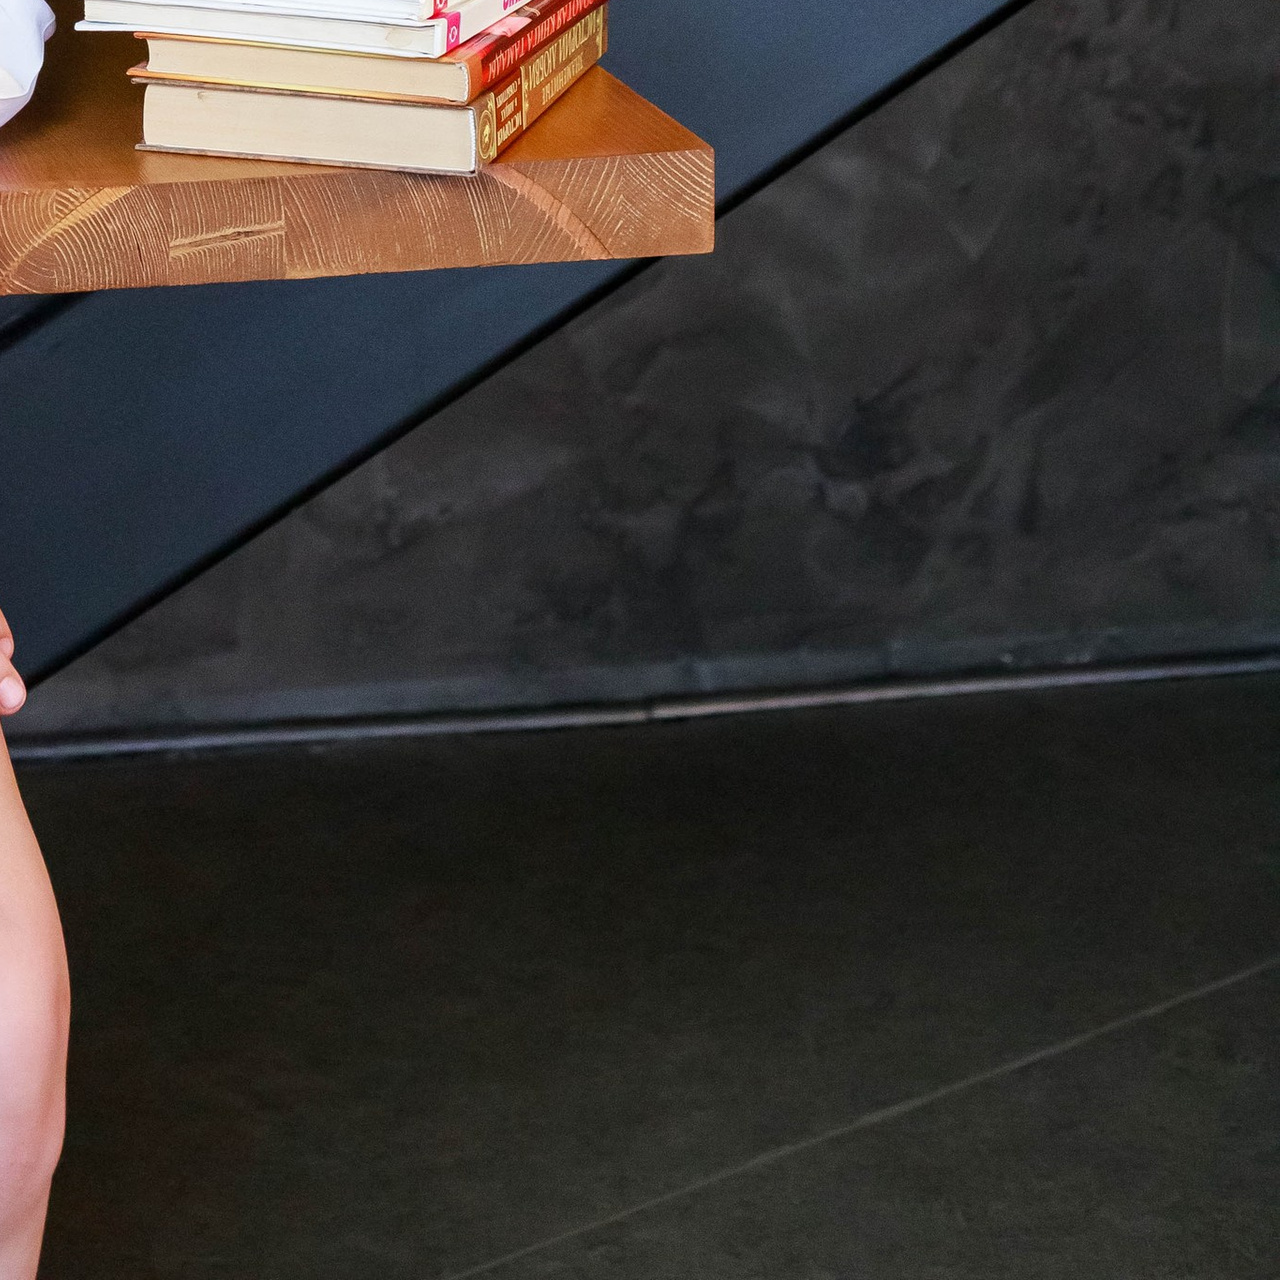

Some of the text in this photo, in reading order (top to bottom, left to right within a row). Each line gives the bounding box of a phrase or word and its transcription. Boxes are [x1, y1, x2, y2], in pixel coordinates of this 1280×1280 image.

[526, 13, 557, 52] КНИГА
[487, 37, 526, 82] ТАМАДЫ
[528, 42, 558, 91] ЛЮБВИ
